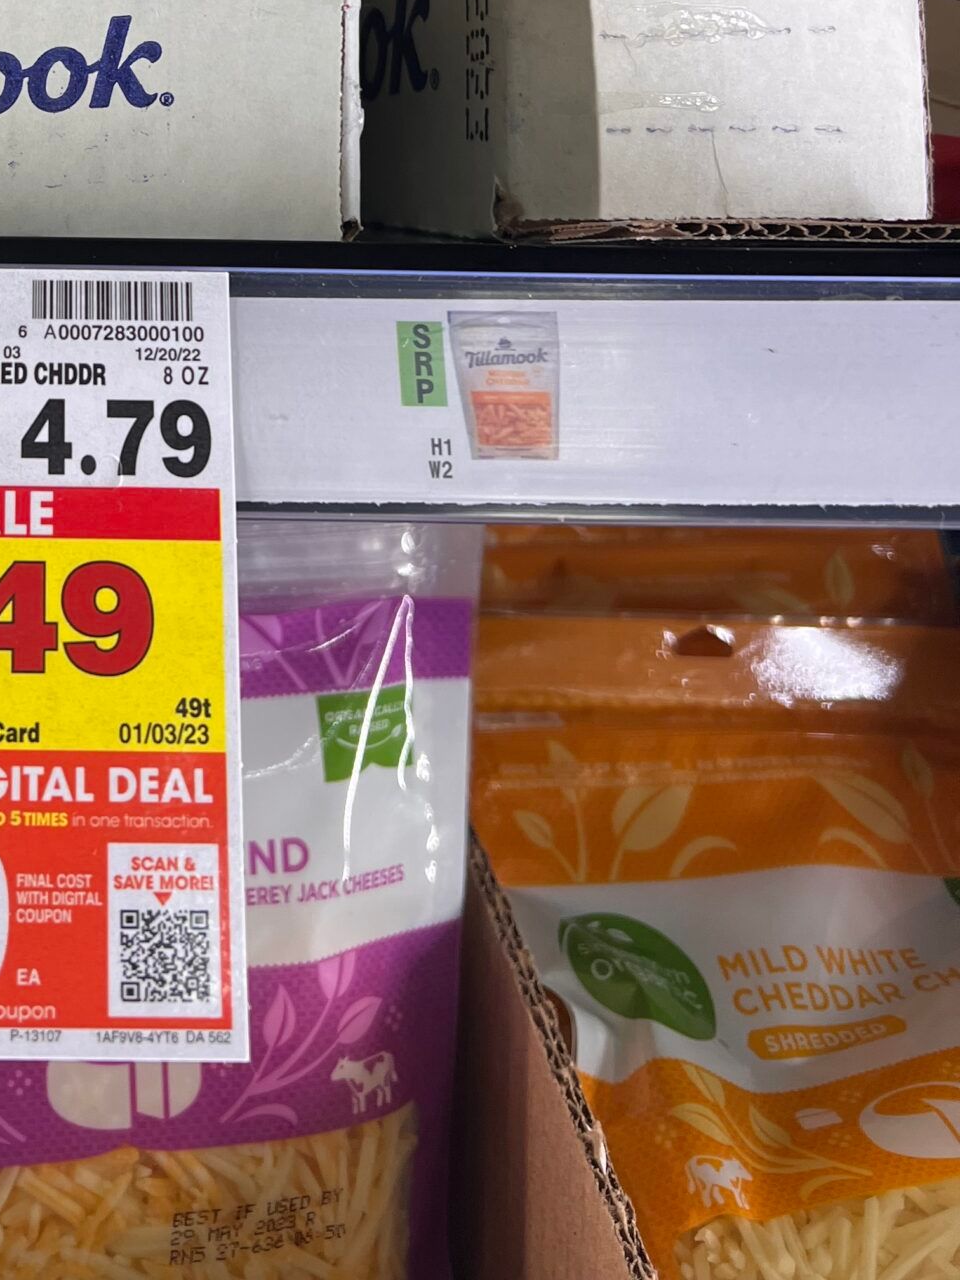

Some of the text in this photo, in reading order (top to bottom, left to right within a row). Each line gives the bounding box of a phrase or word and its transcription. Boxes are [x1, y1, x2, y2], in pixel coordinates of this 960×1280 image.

[18, 324, 205, 342] 6 A0007283000100
[3, 346, 201, 362] 03 12/20/22
[465, 347, 549, 369] Tillamook
[34, 362, 107, 386] CHDDR
[163, 366, 173, 385] 8
[181, 367, 209, 385] OZ
[21, 398, 212, 478] 4.79
[431, 438, 452, 456] H1
[429, 461, 454, 479] W2
[176, 697, 212, 718] 49t
[120, 722, 210, 745] 01/03/23
[109, 767, 213, 804] DEAL
[10, 810, 22, 826] 5
[23, 812, 69, 827] TIMES
[72, 813, 86, 827] in
[90, 815, 120, 829] one
[124, 813, 213, 830] transaction.
[131, 856, 196, 871] SCAN &
[248, 836, 310, 876] ND
[16, 873, 93, 888] FINAL COST
[113, 875, 214, 891] SAVE MORE!
[297, 878, 340, 903] JACK
[341, 863, 405, 896] CHEESES
[16, 890, 103, 906] WITH DIGITAL
[16, 908, 72, 924] COUPON
[717, 945, 809, 982] MILD
[815, 944, 927, 978] WHITE
[17, 968, 41, 986] EA
[732, 979, 905, 1016] CHEDDAR
[10, 1031, 62, 1043] P-13107
[186, 1032, 204, 1044] DA
[208, 1032, 231, 1044] 562
[766, 1023, 887, 1054] SHREDDED
[172, 1188, 344, 1228] BEST IF USED BY
[208, 1223, 244, 1243] MAY
[254, 1215, 297, 1236] 2023
